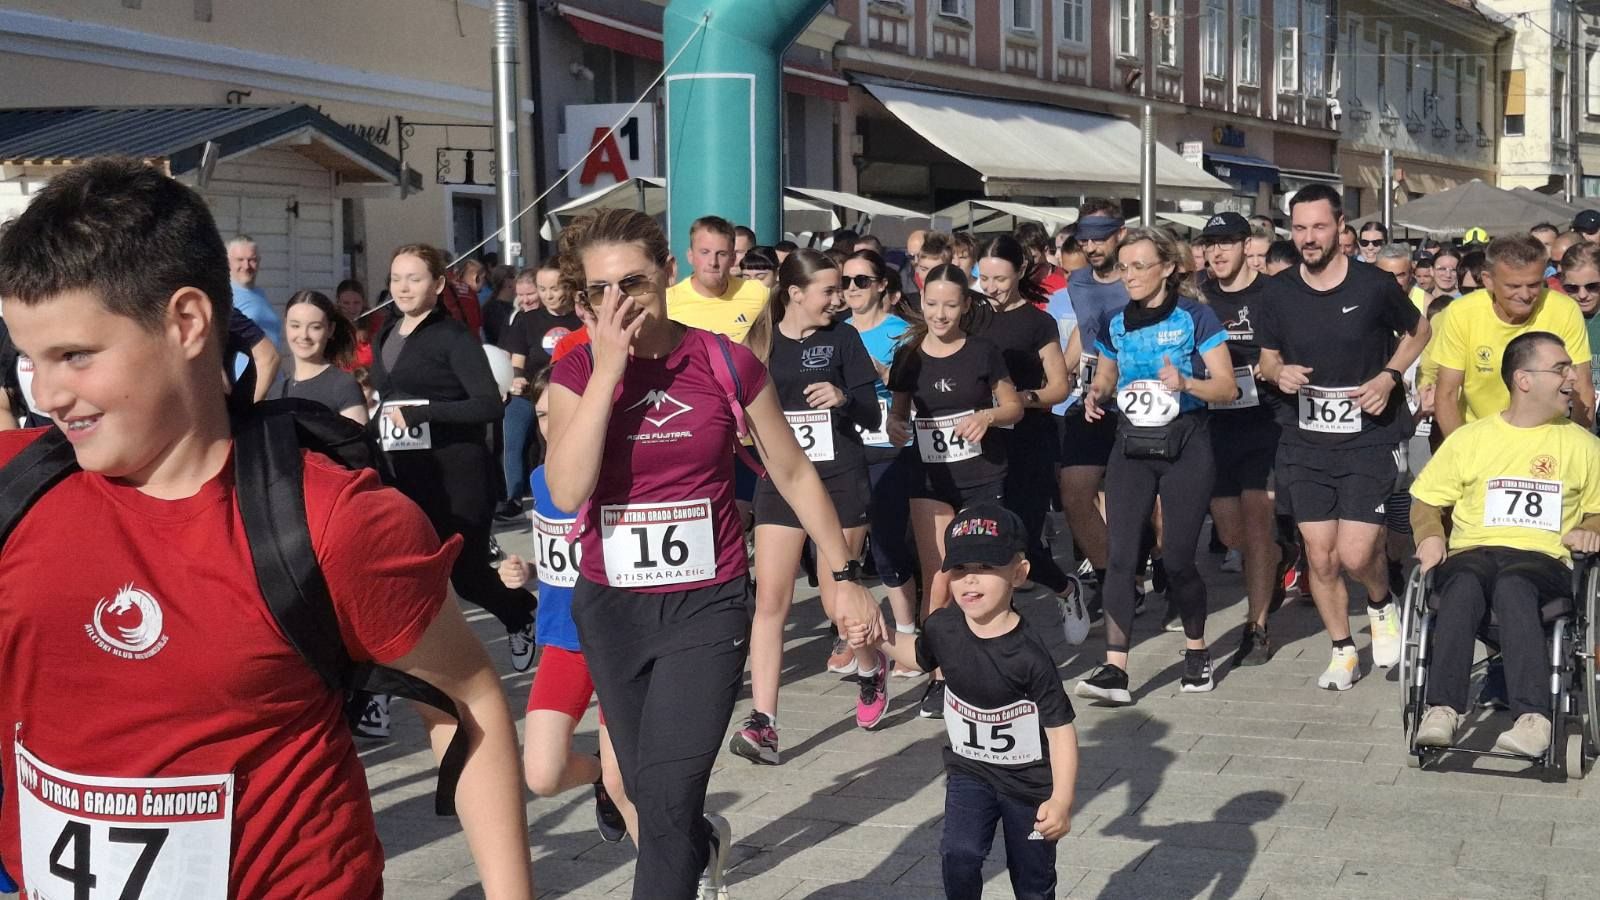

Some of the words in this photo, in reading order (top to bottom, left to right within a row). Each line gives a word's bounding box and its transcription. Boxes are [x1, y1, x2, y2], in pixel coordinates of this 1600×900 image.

[347, 115, 391, 146] red
[578, 116, 640, 186] A1
[801, 345, 834, 360] NIKE
[1124, 391, 1172, 416] 299
[1306, 397, 1354, 423] 162
[626, 433, 651, 441] ASICS
[931, 429, 965, 453] 84
[647, 509, 672, 522] GRADA
[1504, 490, 1543, 517] 78
[630, 525, 689, 569] 16
[962, 717, 1016, 753] 15
[41, 776, 80, 810] UTRKA
[83, 791, 137, 815] GRADA
[141, 789, 219, 817] ČAKOVCA
[49, 819, 170, 900] 47
